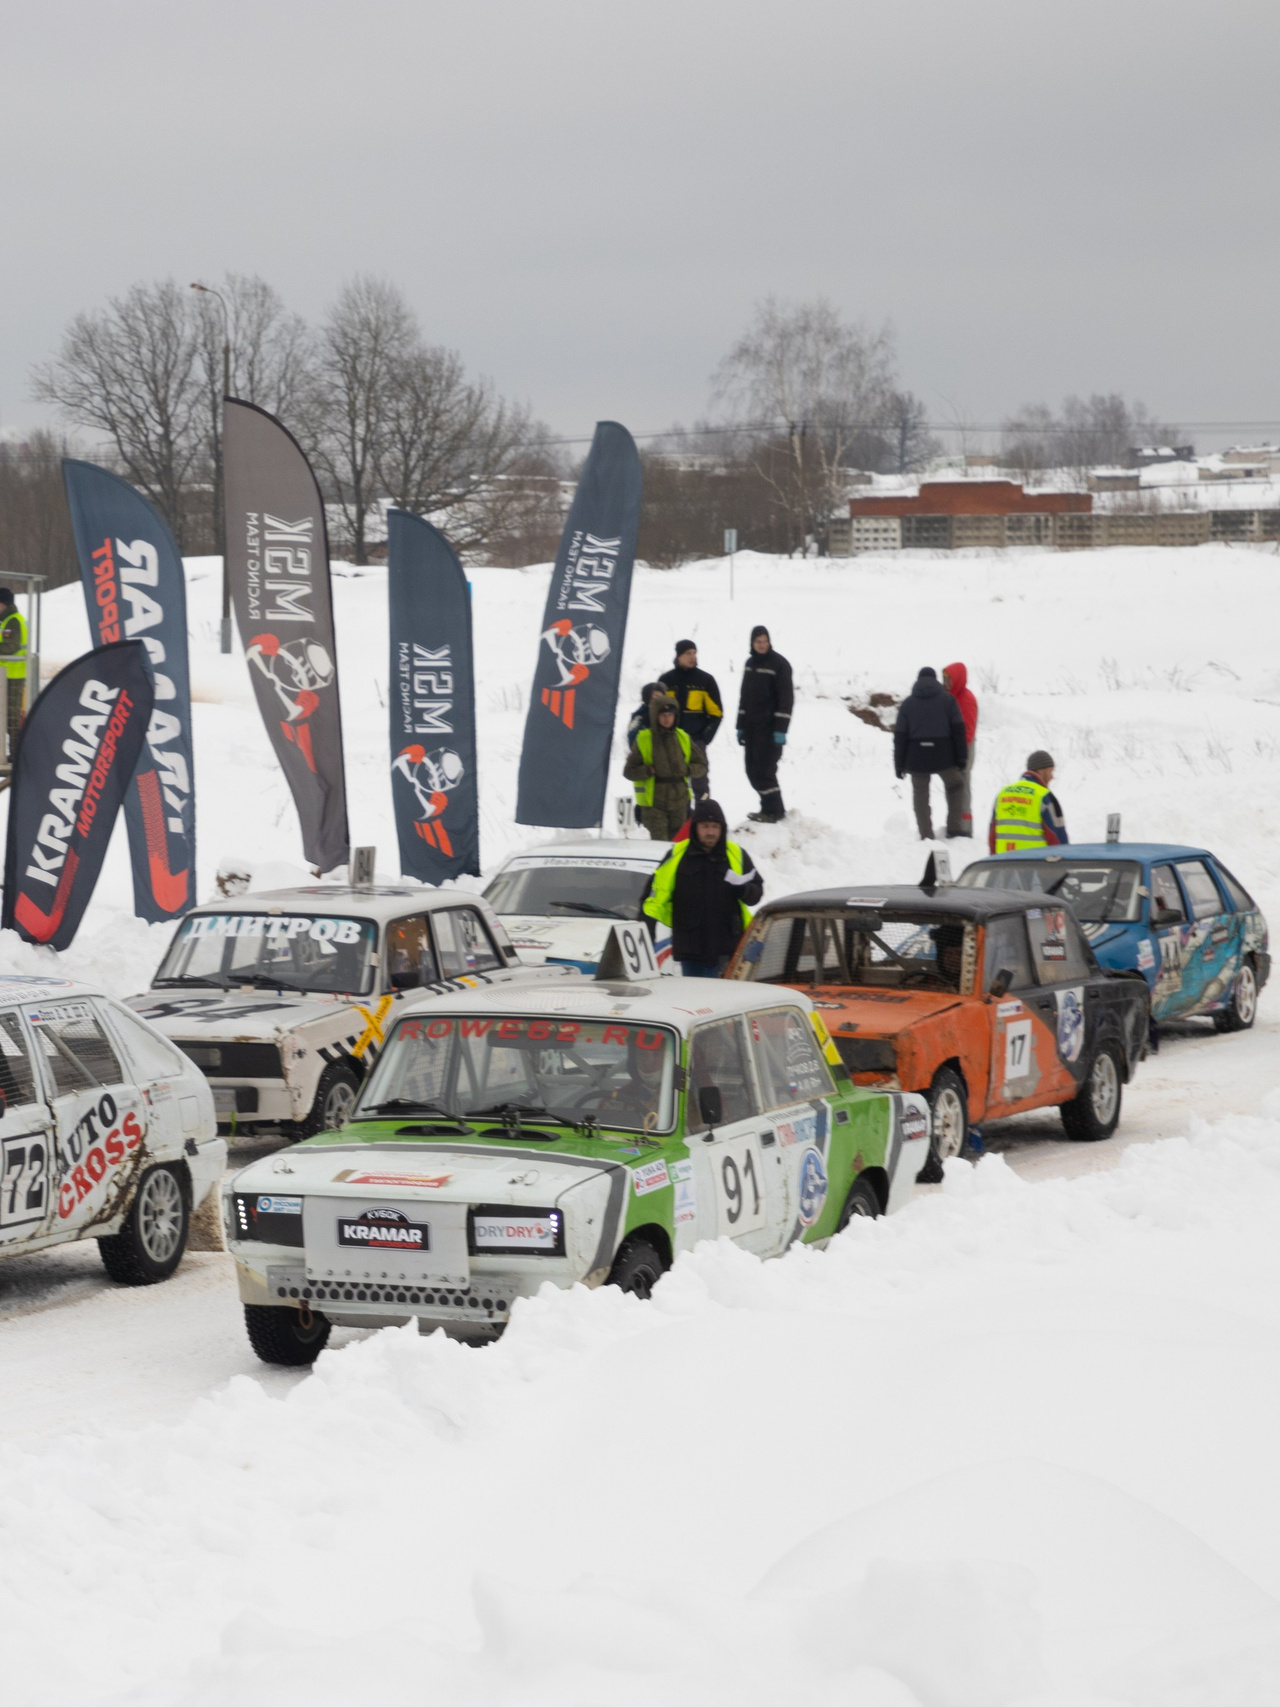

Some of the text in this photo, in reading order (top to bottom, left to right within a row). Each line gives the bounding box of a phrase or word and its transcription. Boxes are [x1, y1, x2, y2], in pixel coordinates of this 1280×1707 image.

[25, 679, 121, 888] KRAMAR
[76, 689, 135, 839] MOTORSPORT
[183, 916, 362, 944] ДМИТРОВ
[623, 928, 655, 974] 91
[398, 1018, 664, 1050] ROWE62.RU
[1011, 1034, 1026, 1067] 17
[58, 1093, 118, 1174] AUTO
[58, 1111, 142, 1220] CROSS
[7, 1143, 45, 1214] 72
[722, 1149, 760, 1224] 91
[343, 1224, 423, 1243] KRAMAR
